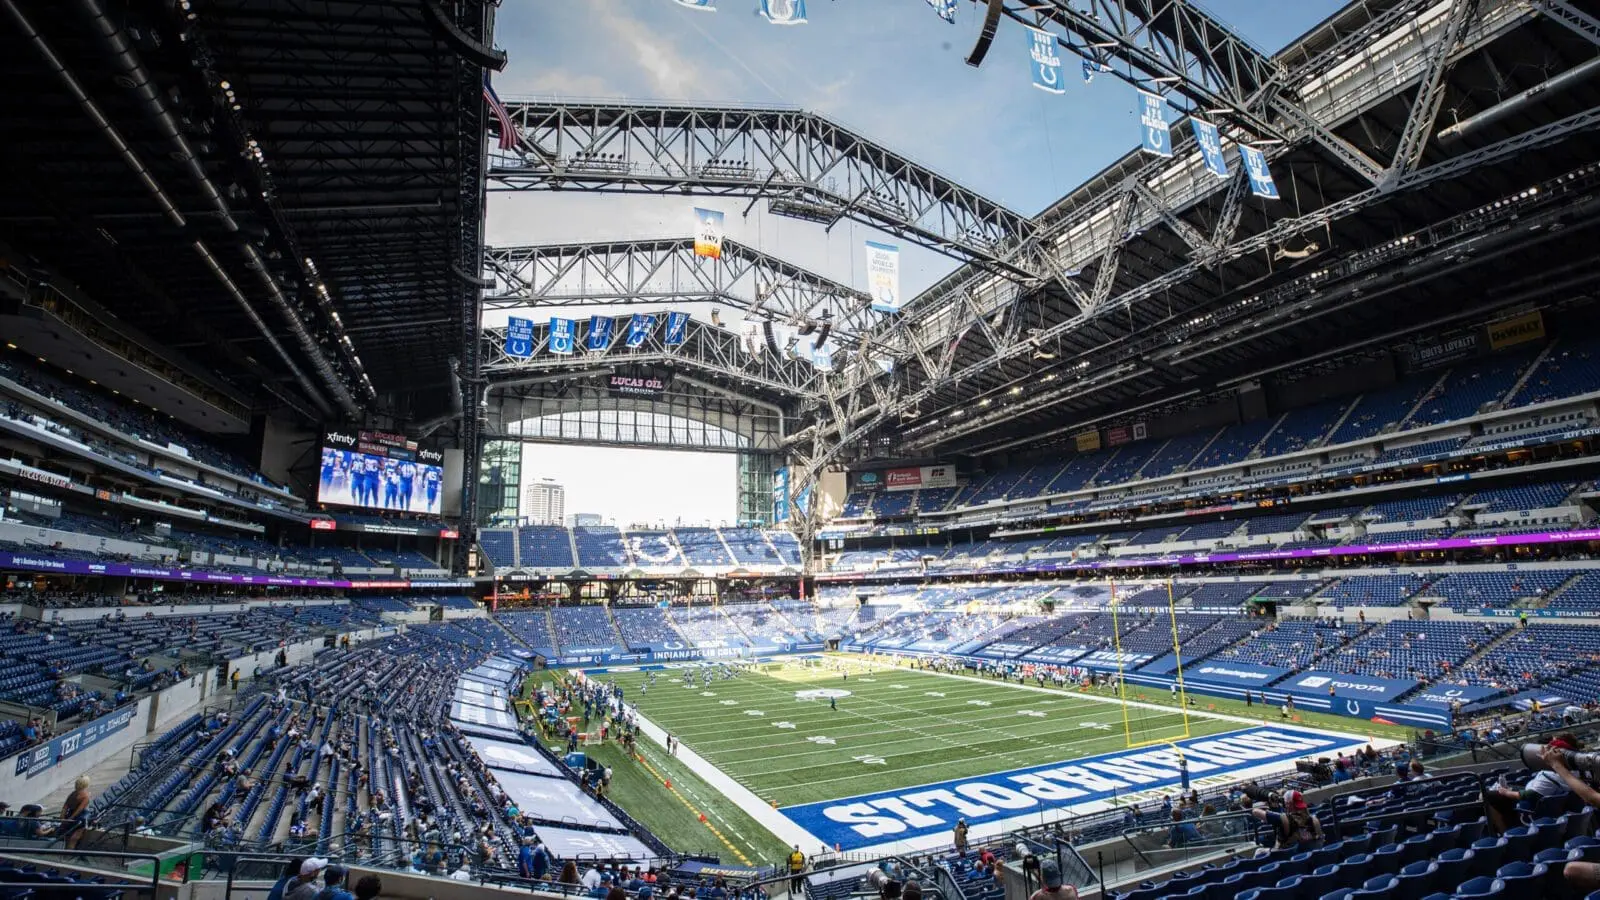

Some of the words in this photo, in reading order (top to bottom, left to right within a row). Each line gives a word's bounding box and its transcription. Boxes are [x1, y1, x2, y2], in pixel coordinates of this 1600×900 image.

[1420, 344, 1444, 359] COLTS
[1445, 335, 1476, 352] LOYALTY
[611, 376, 643, 387] LUCAS
[646, 378, 663, 389] OIL
[619, 386, 654, 395] STADIUM
[327, 432, 356, 446] xfinity
[1563, 431, 1579, 439] JEFF
[419, 449, 442, 462] xfinity
[1449, 447, 1479, 457] MARSHALL
[1493, 609, 1516, 617] TEXT
[1330, 681, 1386, 693] TOYOTA
[61, 732, 82, 756] TEXT
[34, 746, 50, 763] NEED
[822, 729, 1337, 838] INDIANAPOLIS
